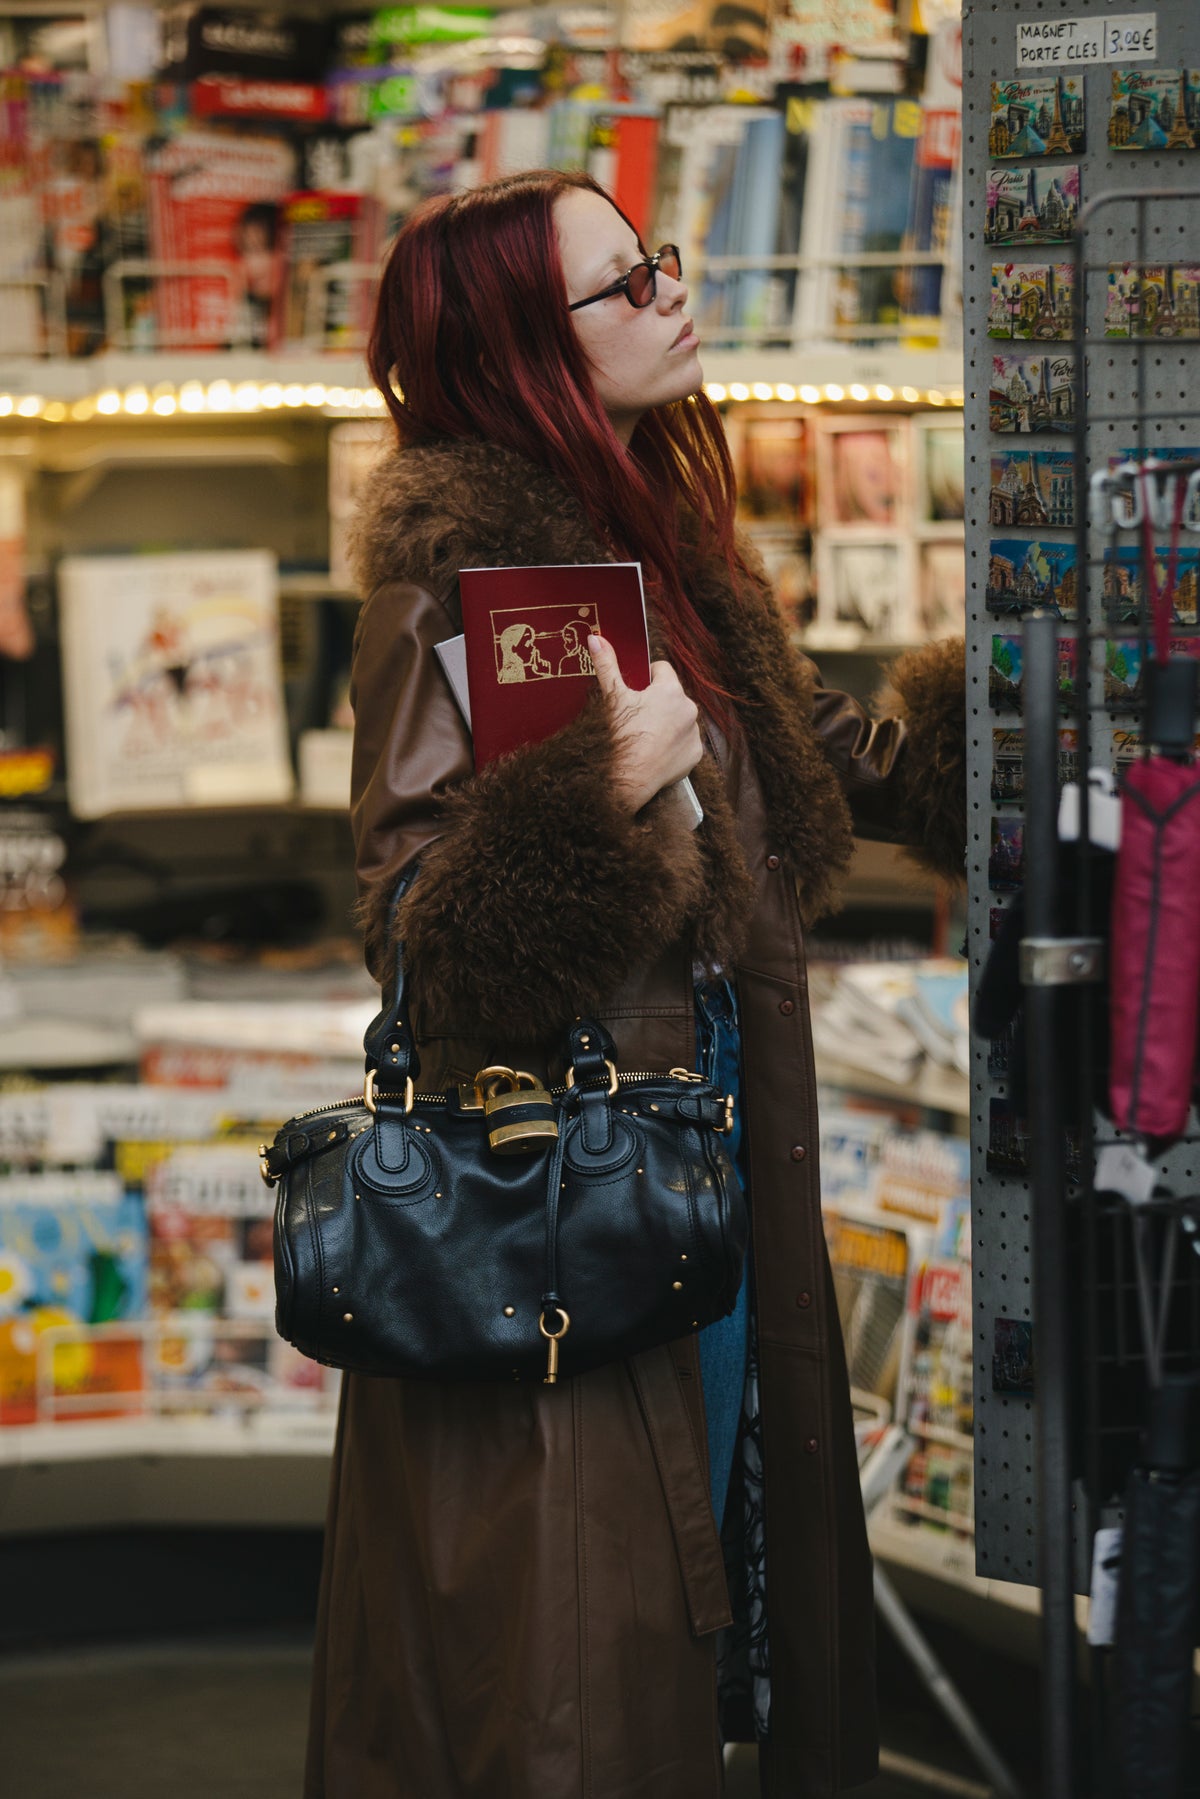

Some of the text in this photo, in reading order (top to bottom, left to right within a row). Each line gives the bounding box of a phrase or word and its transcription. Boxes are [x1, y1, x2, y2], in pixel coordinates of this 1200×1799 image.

[1021, 22, 1077, 40] MAGNET
[1021, 42, 1097, 62] PORTE CLES
[1003, 81, 1031, 101] Paris
